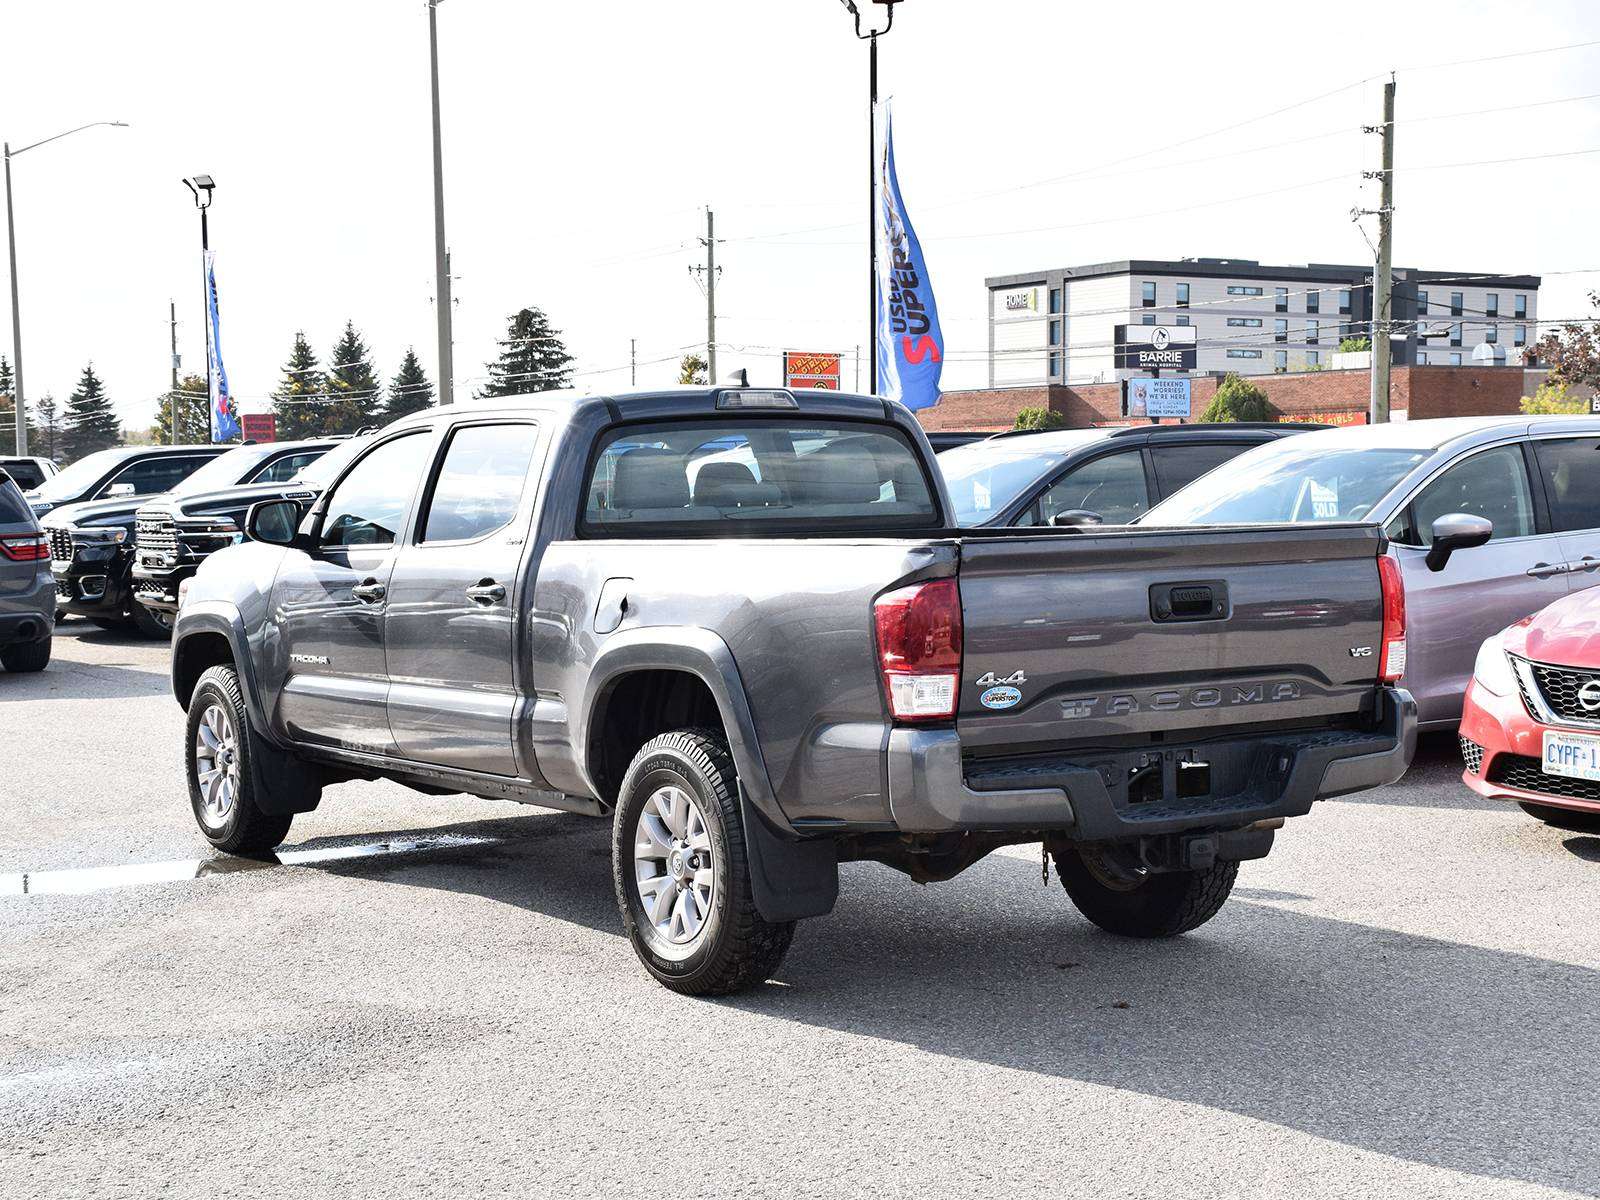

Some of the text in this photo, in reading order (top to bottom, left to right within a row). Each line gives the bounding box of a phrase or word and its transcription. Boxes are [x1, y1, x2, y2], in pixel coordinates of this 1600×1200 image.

[1006, 294, 1028, 306] HOME
[1140, 351, 1182, 362] BARRIE
[1312, 502, 1337, 518] SOLD
[1349, 646, 1372, 657] V6
[290, 654, 328, 664] TACOMA
[975, 669, 1028, 687] 4x4
[1059, 681, 1300, 719] TACOMA
